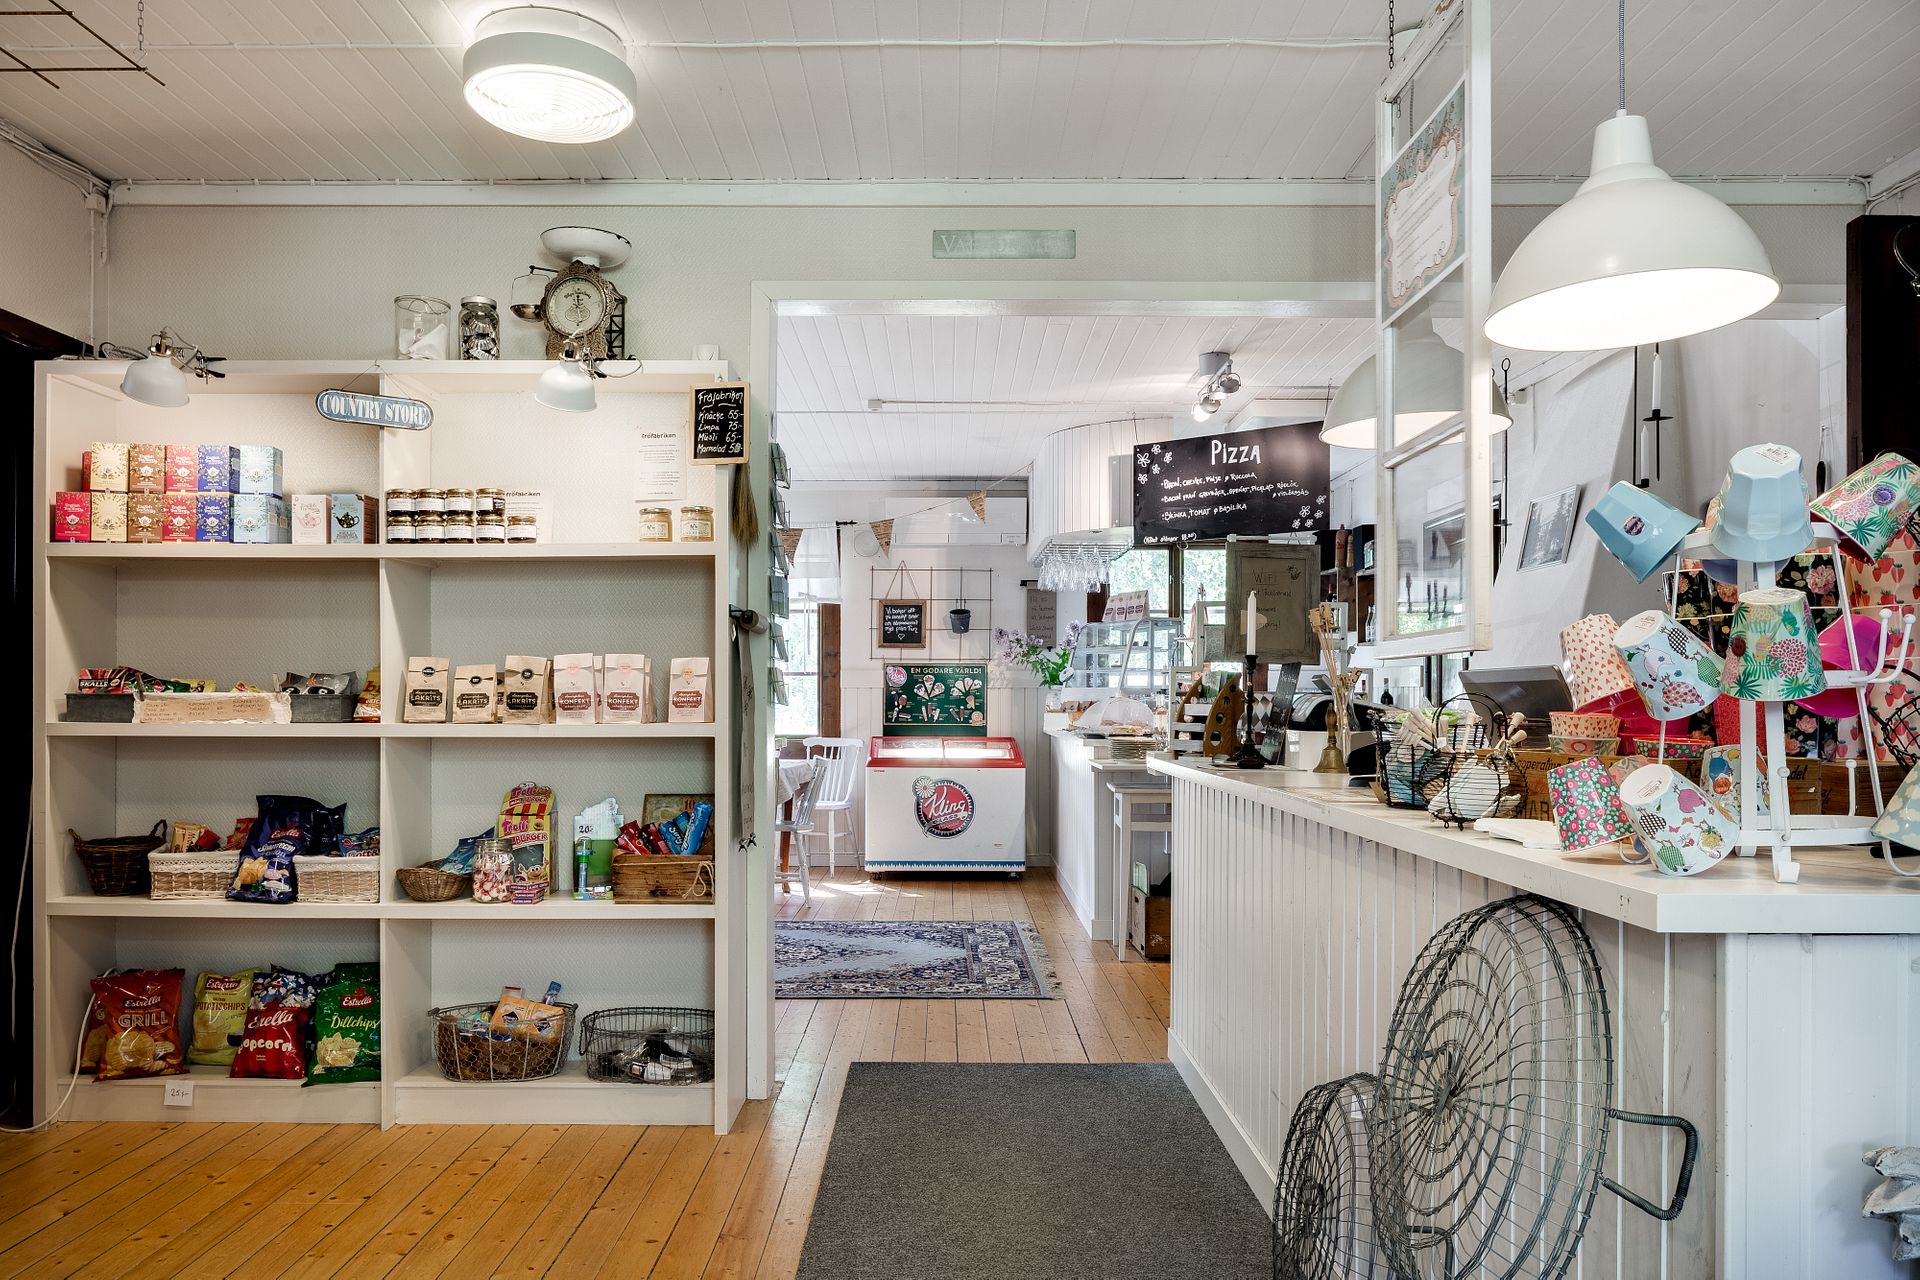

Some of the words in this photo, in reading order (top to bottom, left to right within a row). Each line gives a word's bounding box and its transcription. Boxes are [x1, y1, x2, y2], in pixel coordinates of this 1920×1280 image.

[322, 395, 382, 419] COUNTRY
[385, 401, 427, 425] STORE
[698, 423, 720, 432] Limpa
[1211, 439, 1262, 466] PIZZA
[924, 786, 966, 819] Kling
[502, 820, 529, 834] Trolli
[515, 832, 548, 845] BURGER
[206, 979, 239, 990] Estrella
[124, 996, 161, 1008] Estrella
[342, 996, 372, 1006] Estrella
[118, 1010, 168, 1028] GRILL
[330, 1013, 377, 1031] Dillchips
